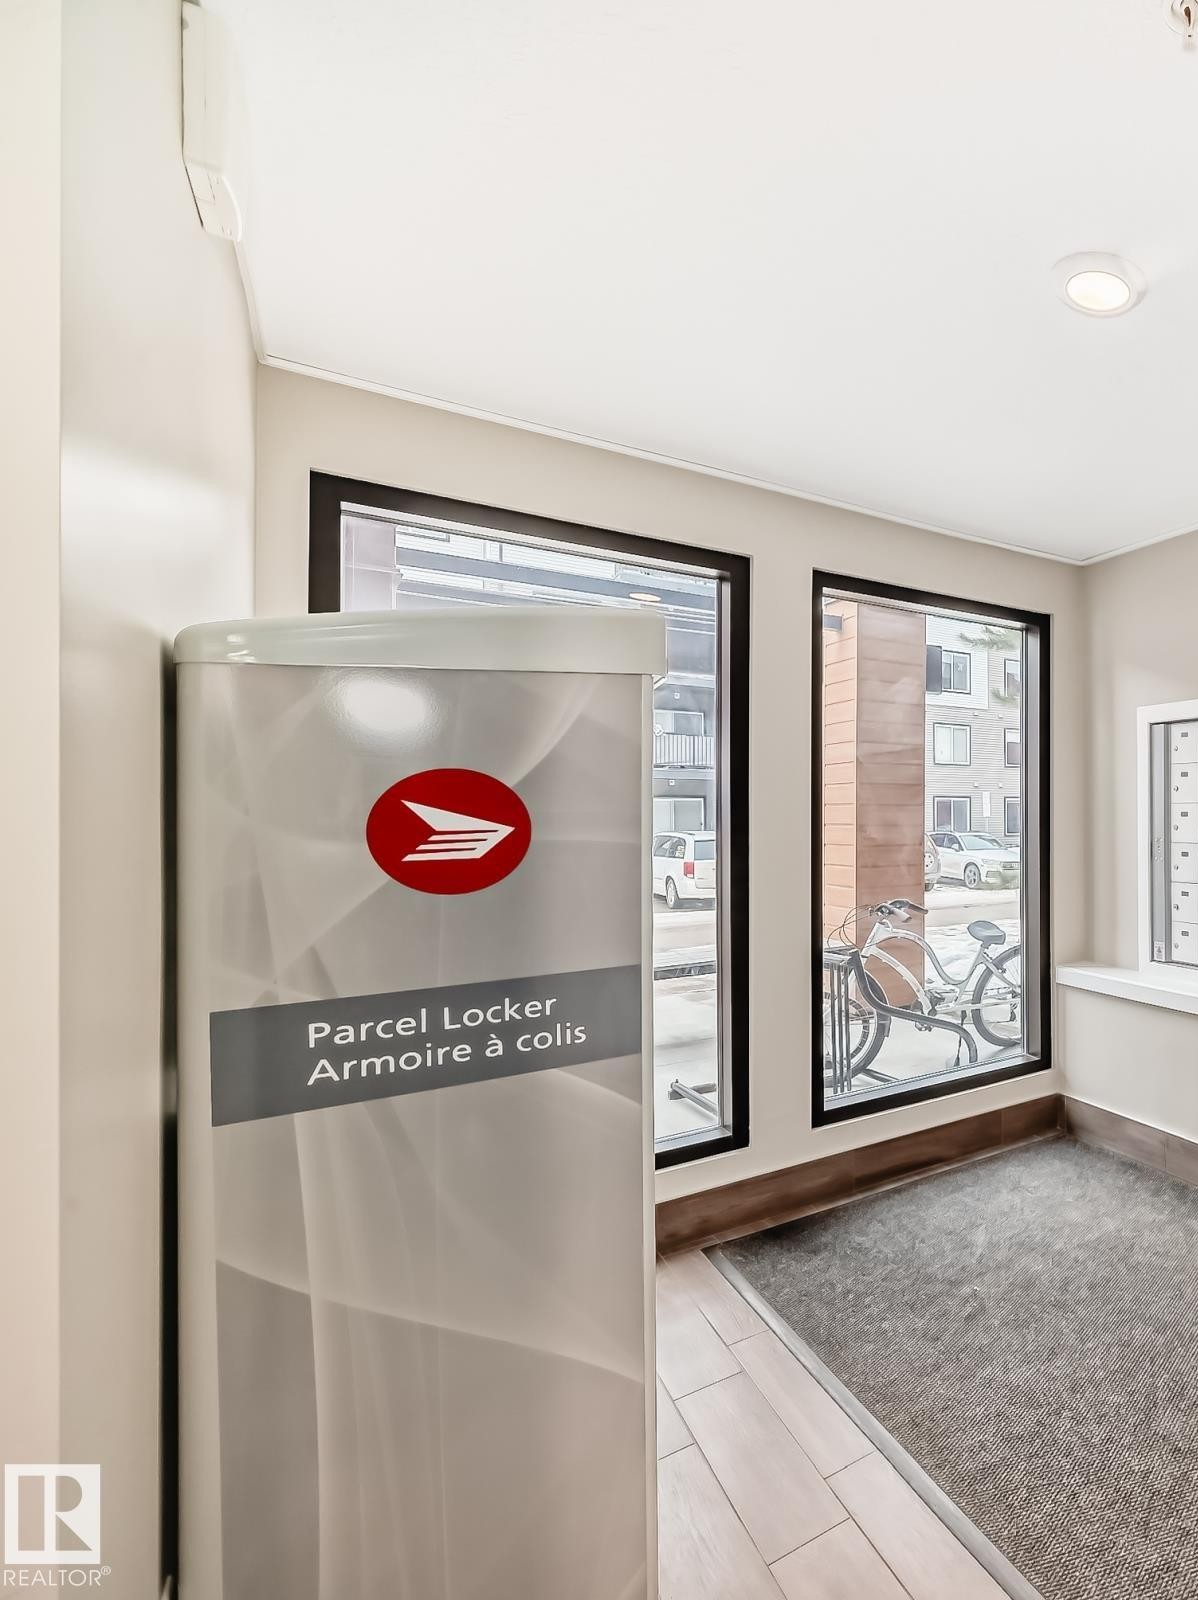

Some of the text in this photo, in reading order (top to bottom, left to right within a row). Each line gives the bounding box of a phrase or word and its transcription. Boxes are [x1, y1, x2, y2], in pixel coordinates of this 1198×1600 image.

[307, 997, 557, 1048] Parcel Locker
[306, 1022, 587, 1086] Armoire à colis
